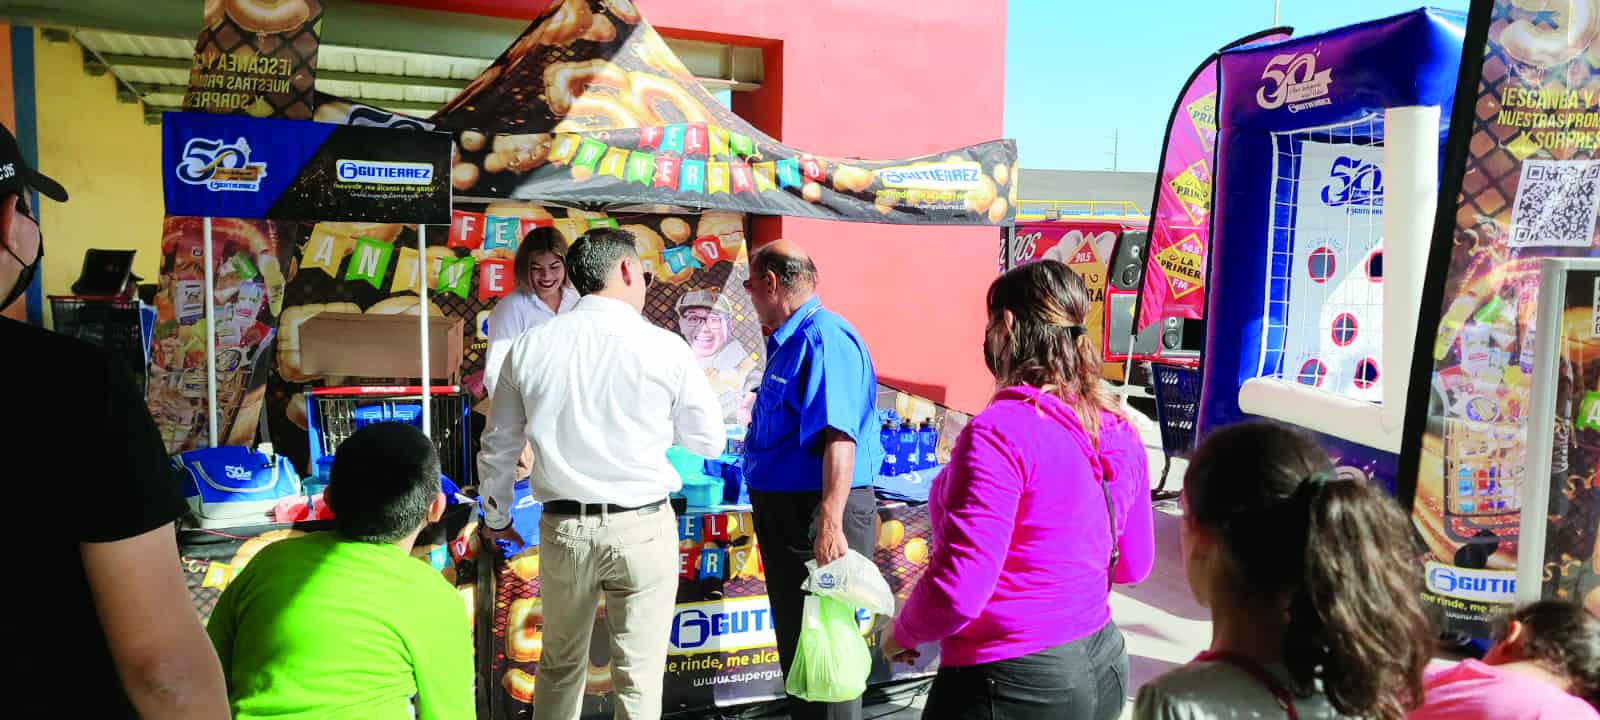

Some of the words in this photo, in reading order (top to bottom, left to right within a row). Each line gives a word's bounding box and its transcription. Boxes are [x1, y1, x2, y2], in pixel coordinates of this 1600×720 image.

[1256, 53, 1315, 110] 50
[1498, 110, 1565, 128] NUESTRAS
[1567, 113, 1600, 129] PROM
[357, 166, 431, 179] GUTIERREZ
[1160, 260, 1200, 280] PRIMER
[711, 608, 775, 636] GUTI
[681, 655, 724, 672] rinde,
[727, 653, 749, 667] me
[752, 650, 780, 664] alca
